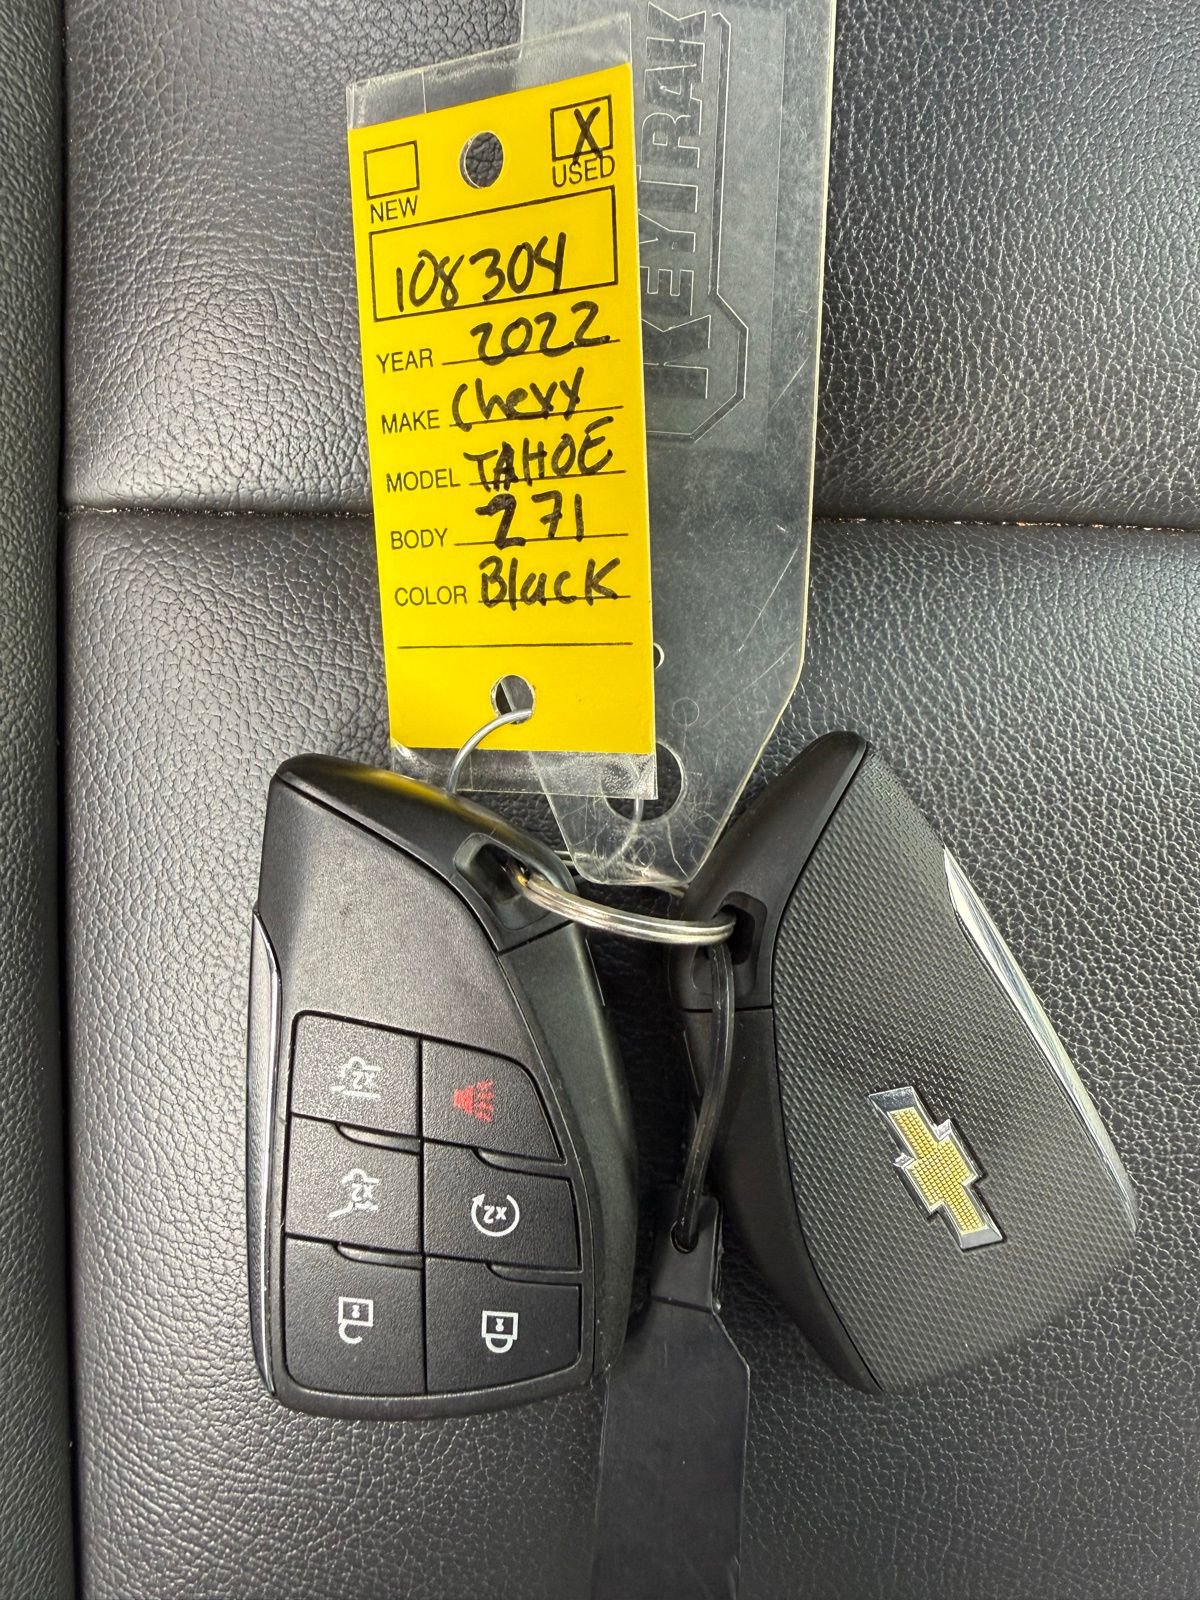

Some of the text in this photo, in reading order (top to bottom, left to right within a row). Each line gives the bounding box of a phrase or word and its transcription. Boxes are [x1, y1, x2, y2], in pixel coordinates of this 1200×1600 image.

[552, 154, 616, 188] USED
[369, 195, 419, 225] NEW
[395, 231, 567, 312] 108304
[469, 300, 611, 366] 2022
[376, 348, 435, 374] YEAR
[381, 409, 440, 435] MAKE
[463, 416, 615, 492] TAHOE
[386, 468, 461, 494] MODEL
[390, 527, 449, 551] BODY
[394, 585, 468, 607] COLOR
[478, 555, 622, 612] Black
